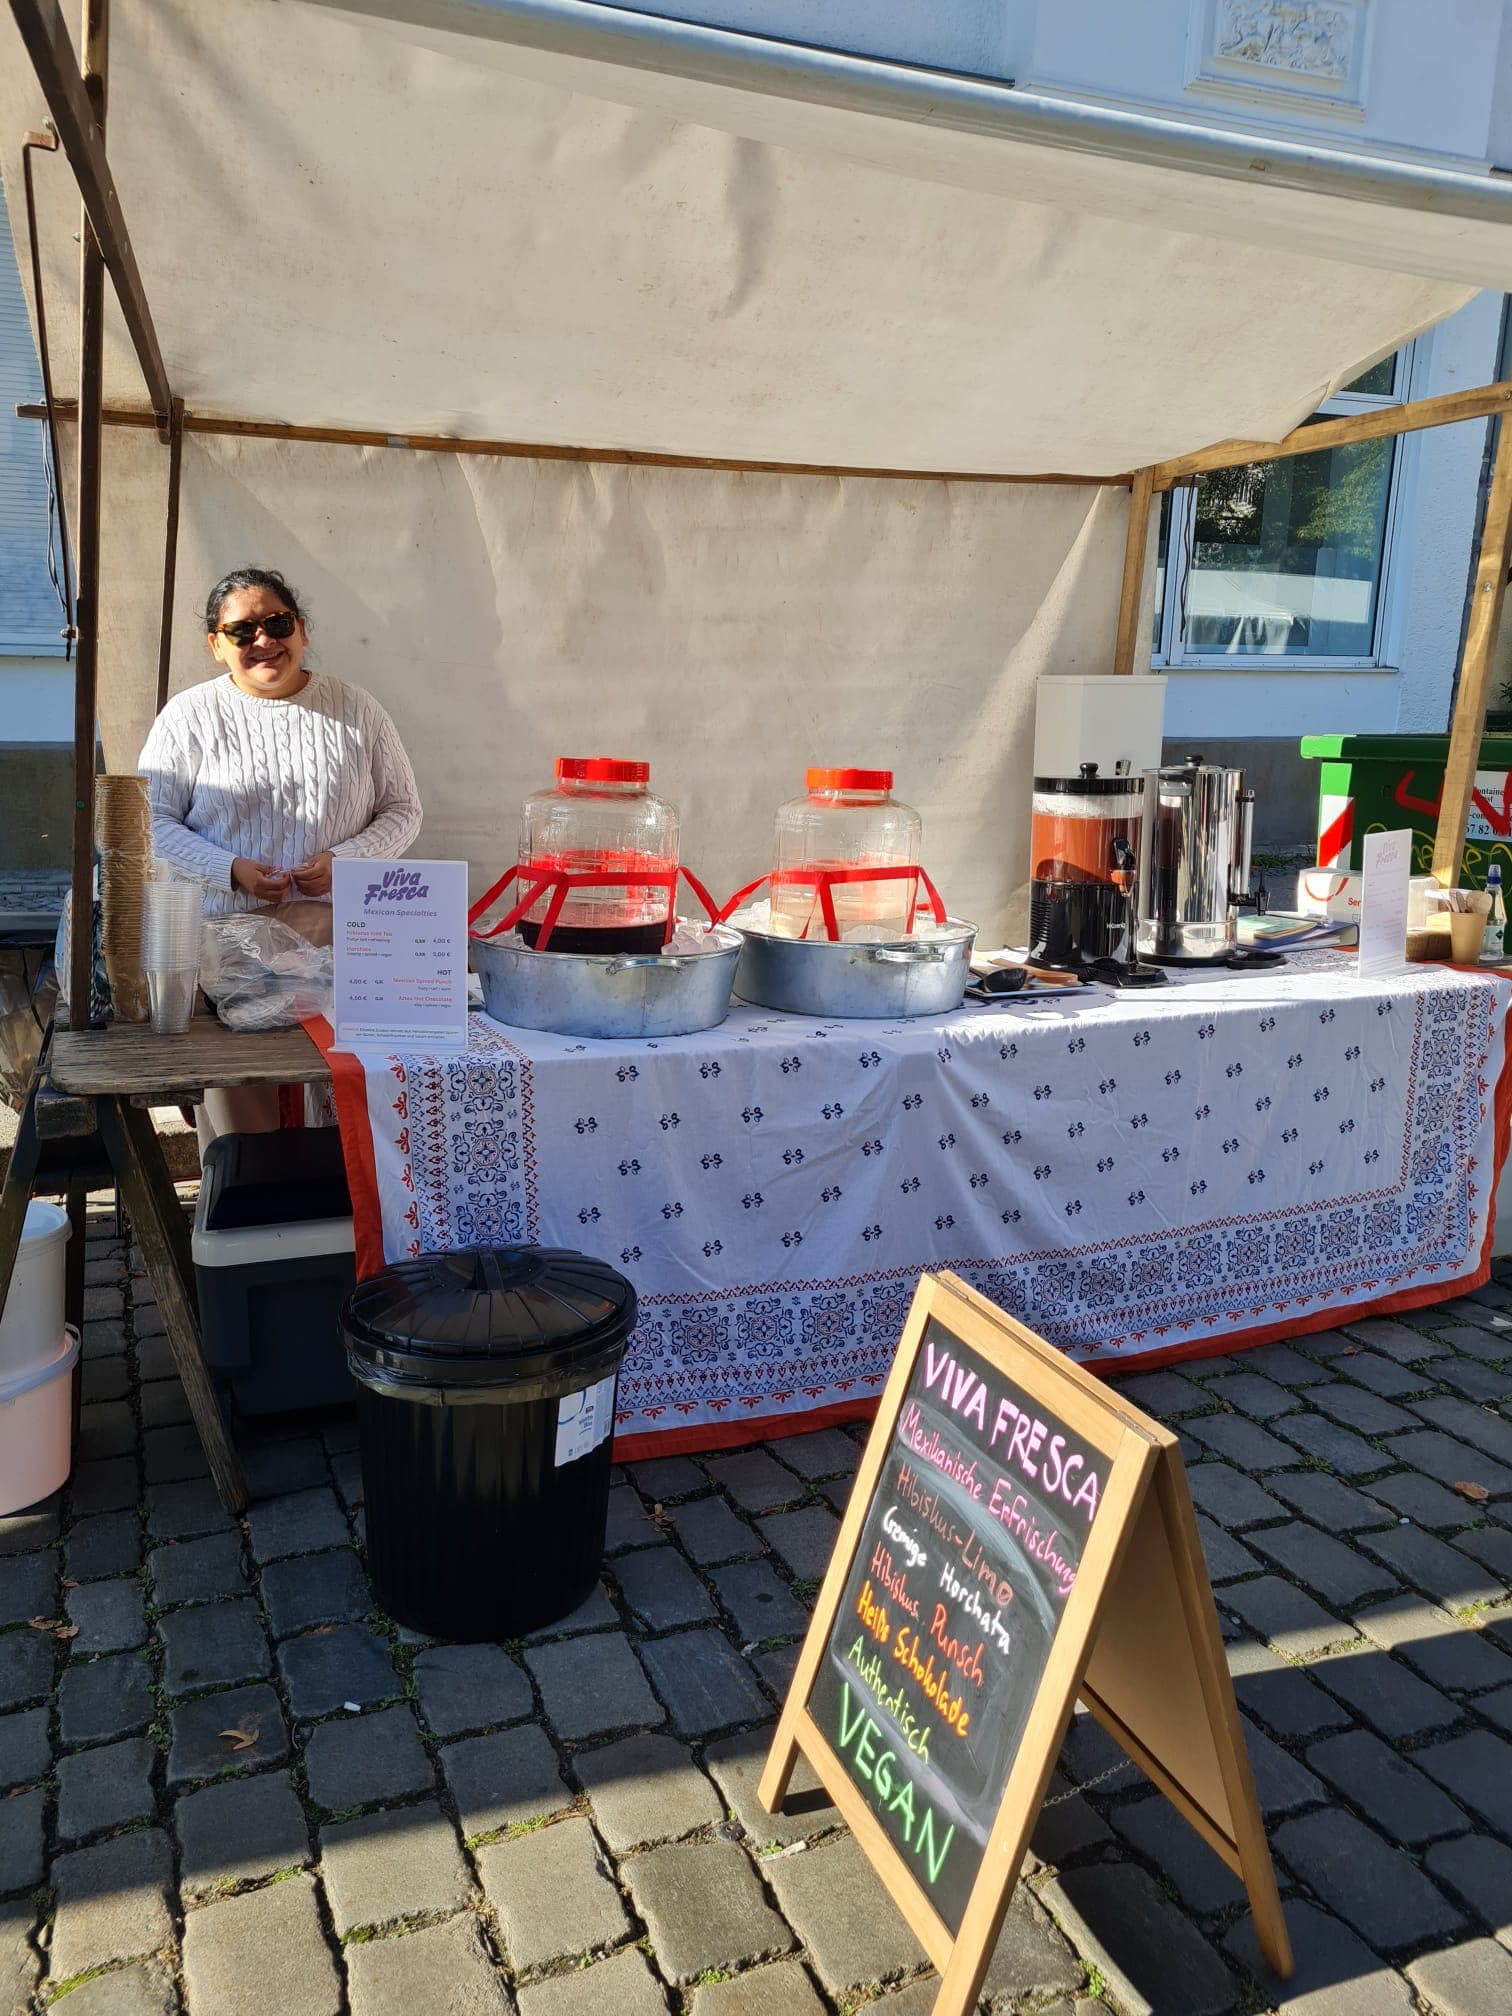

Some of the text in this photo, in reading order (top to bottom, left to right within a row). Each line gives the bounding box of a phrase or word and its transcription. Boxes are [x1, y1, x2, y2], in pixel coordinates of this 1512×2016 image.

[363, 884, 429, 906] Fresca
[363, 908, 438, 917] Mexican Specialties
[382, 868, 422, 889] Viva
[924, 1342, 1101, 1522] VIVA FRESCA
[929, 1602, 985, 1687] Punsch
[939, 1561, 1011, 1656] Horchata
[848, 1634, 931, 1765] Authentisch
[893, 1625, 971, 1737] Schokolade
[839, 1681, 956, 1884] VEGAN
